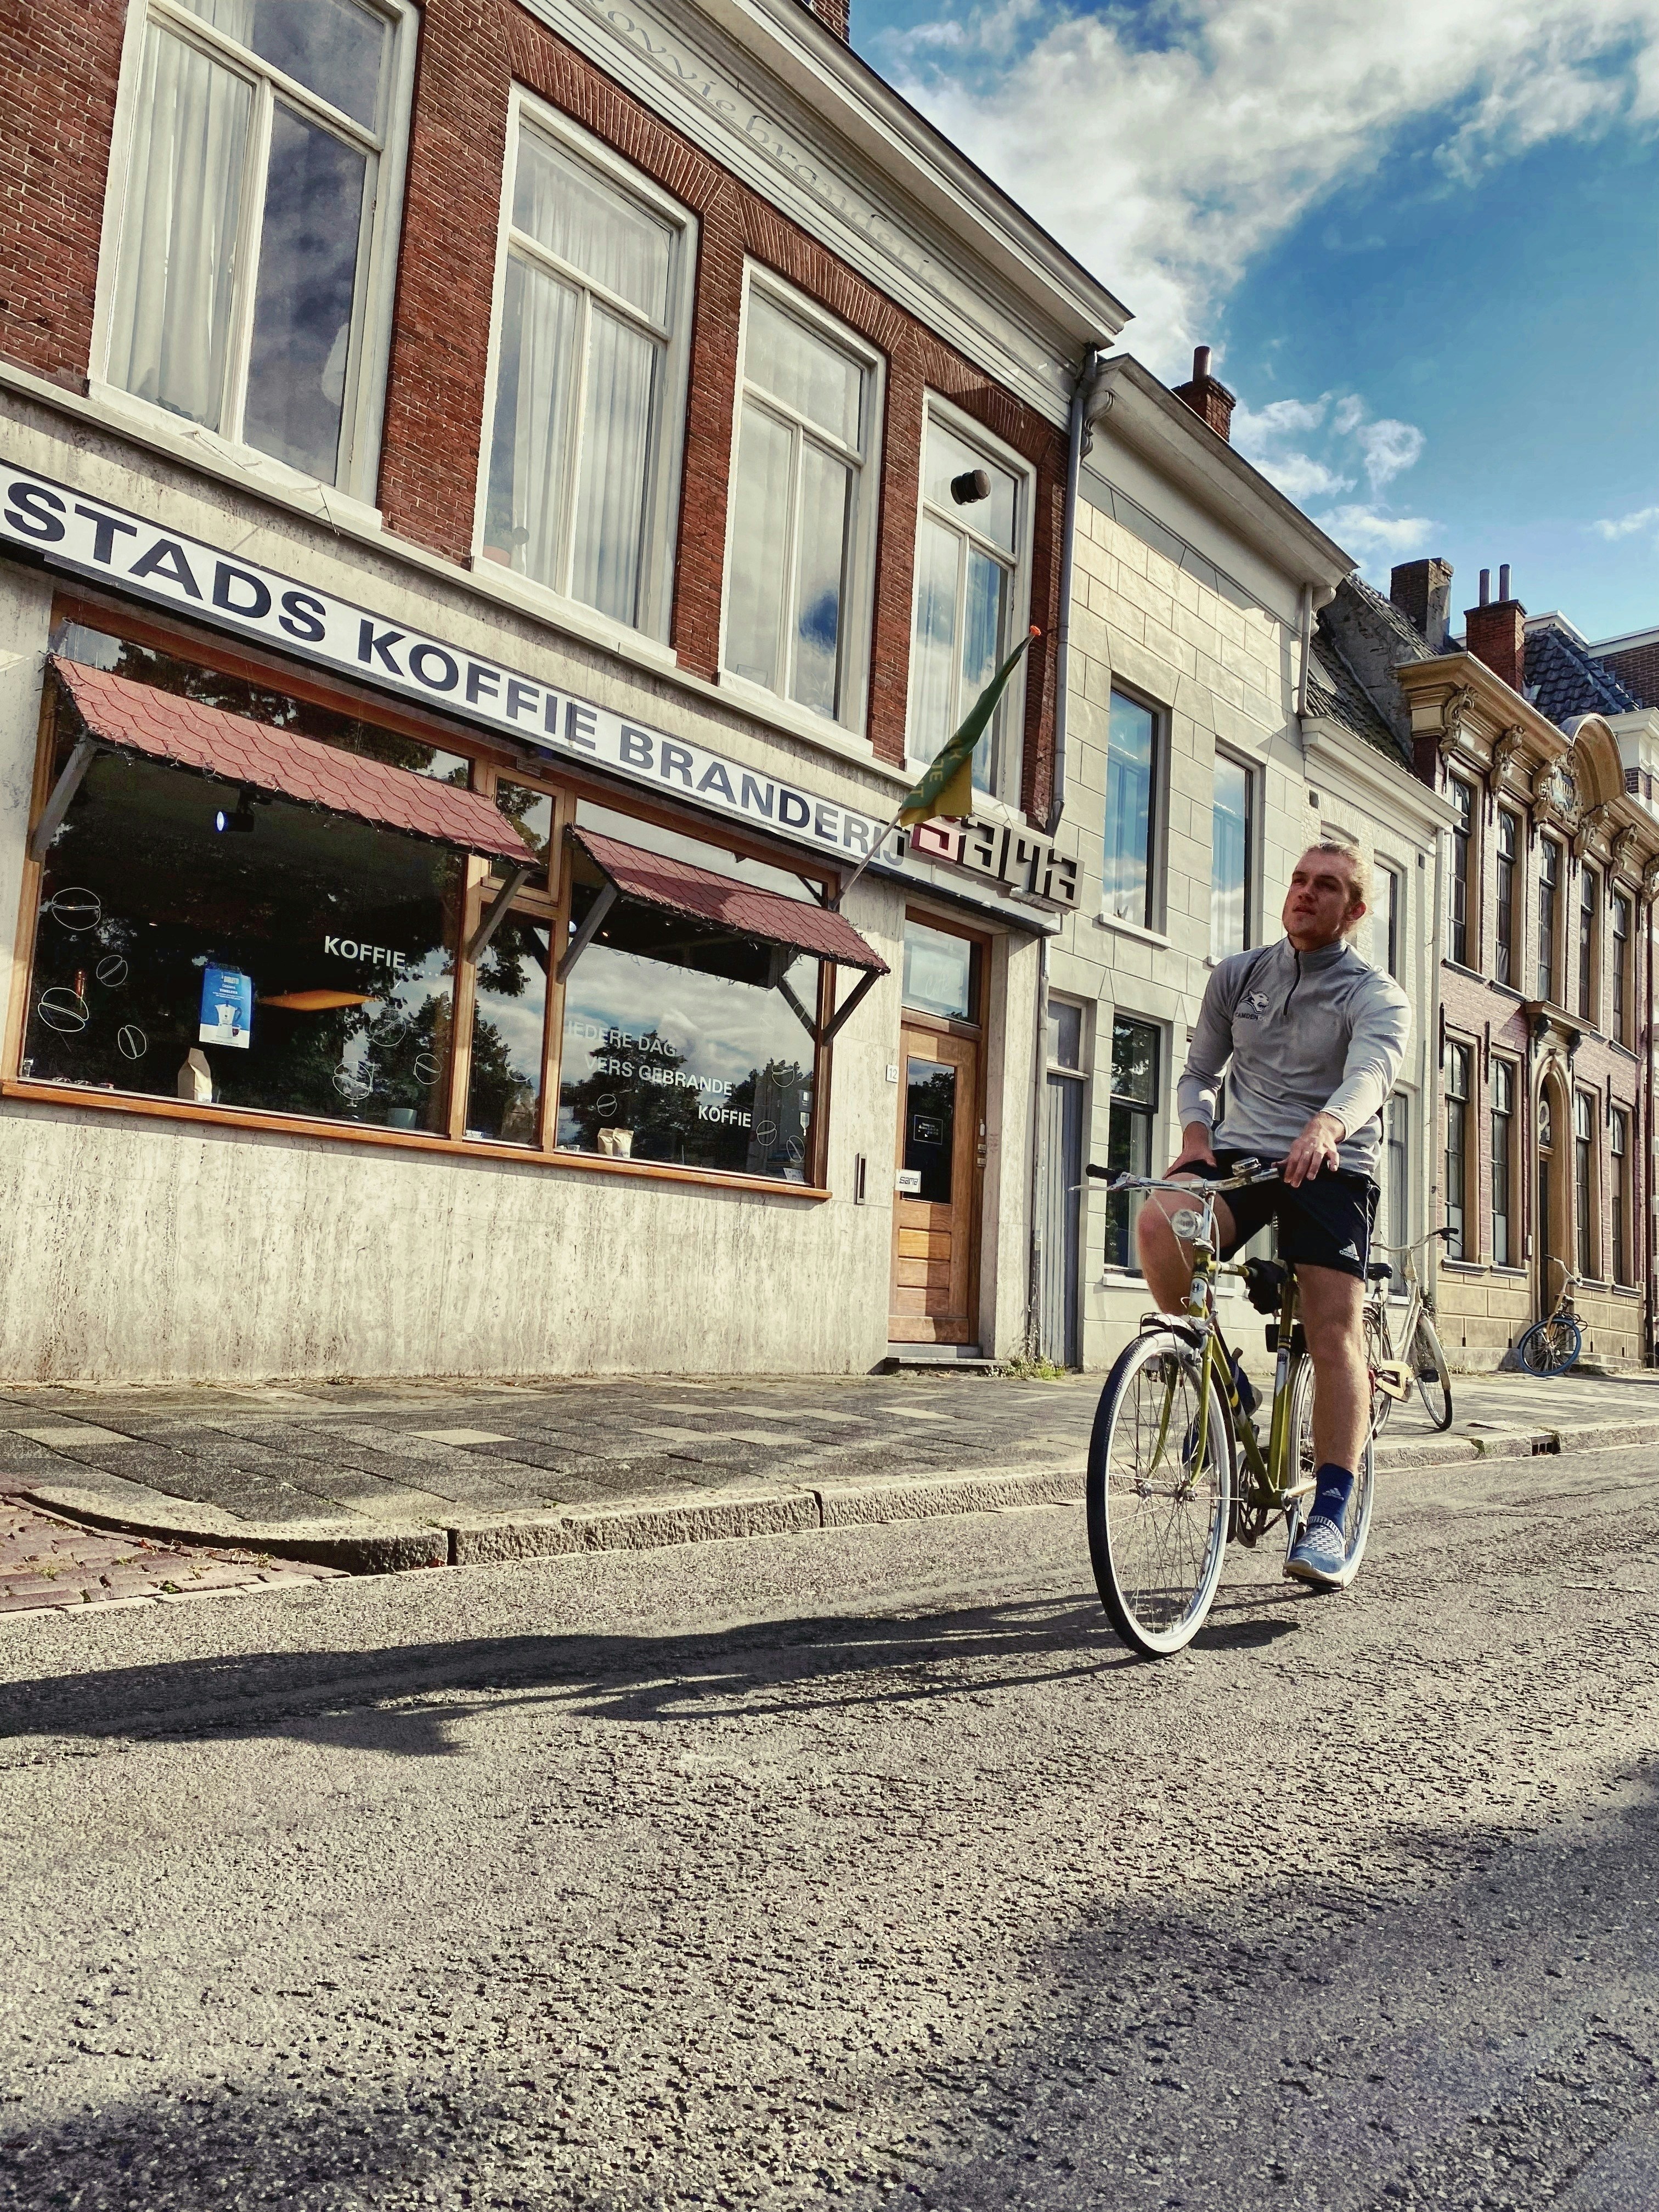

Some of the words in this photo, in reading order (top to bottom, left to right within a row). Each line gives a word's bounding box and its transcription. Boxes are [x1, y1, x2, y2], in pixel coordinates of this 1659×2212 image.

[4, 482, 326, 642] STADS
[358, 618, 597, 751] KOFFIE
[619, 724, 905, 866] BRANDERIJ
[568, 1020, 633, 1048] IEDERE
[639, 1036, 676, 1057] DAG
[585, 1054, 633, 1077] VERS
[639, 1065, 732, 1096] GEBRANDE
[889, 1068, 898, 1080] 12
[698, 1105, 752, 1127] KOFFIE
